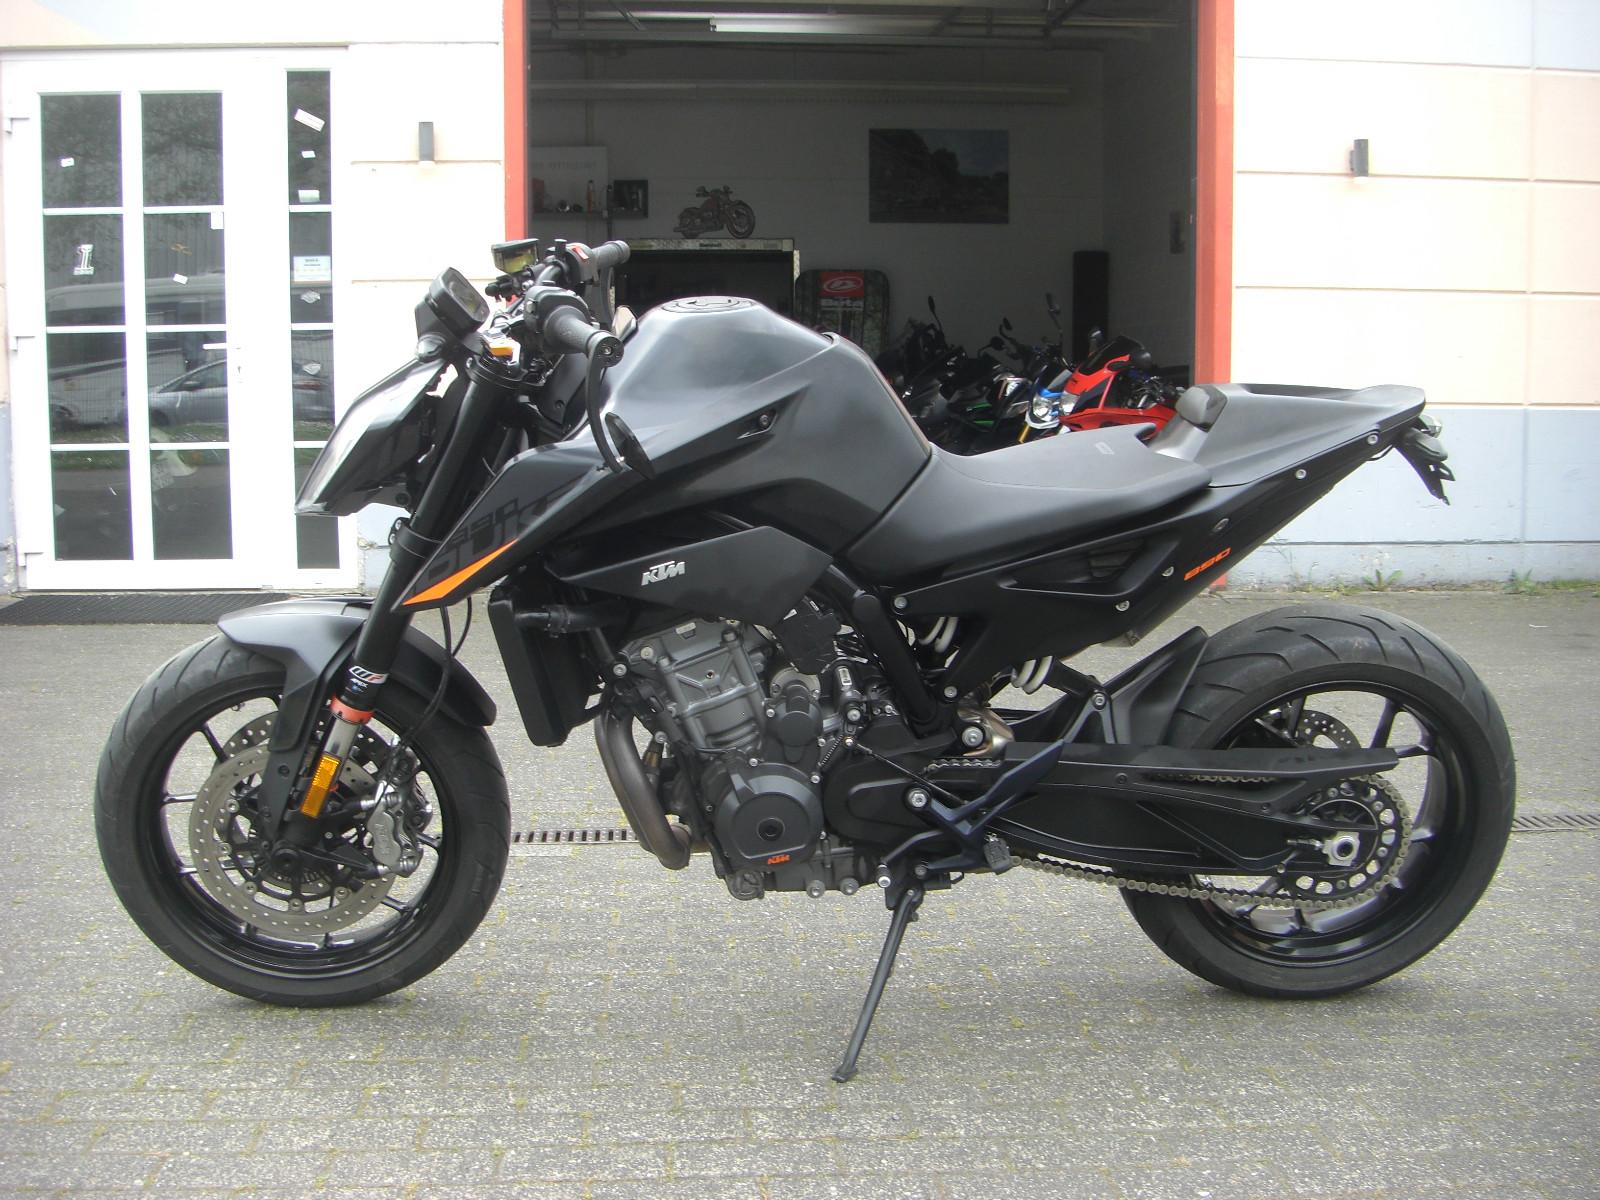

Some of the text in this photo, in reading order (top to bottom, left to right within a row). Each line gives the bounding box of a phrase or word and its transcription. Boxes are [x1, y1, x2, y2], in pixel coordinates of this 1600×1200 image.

[641, 560, 686, 586] KTM
[1183, 547, 1232, 581] 890
[767, 854, 792, 865] KTM
